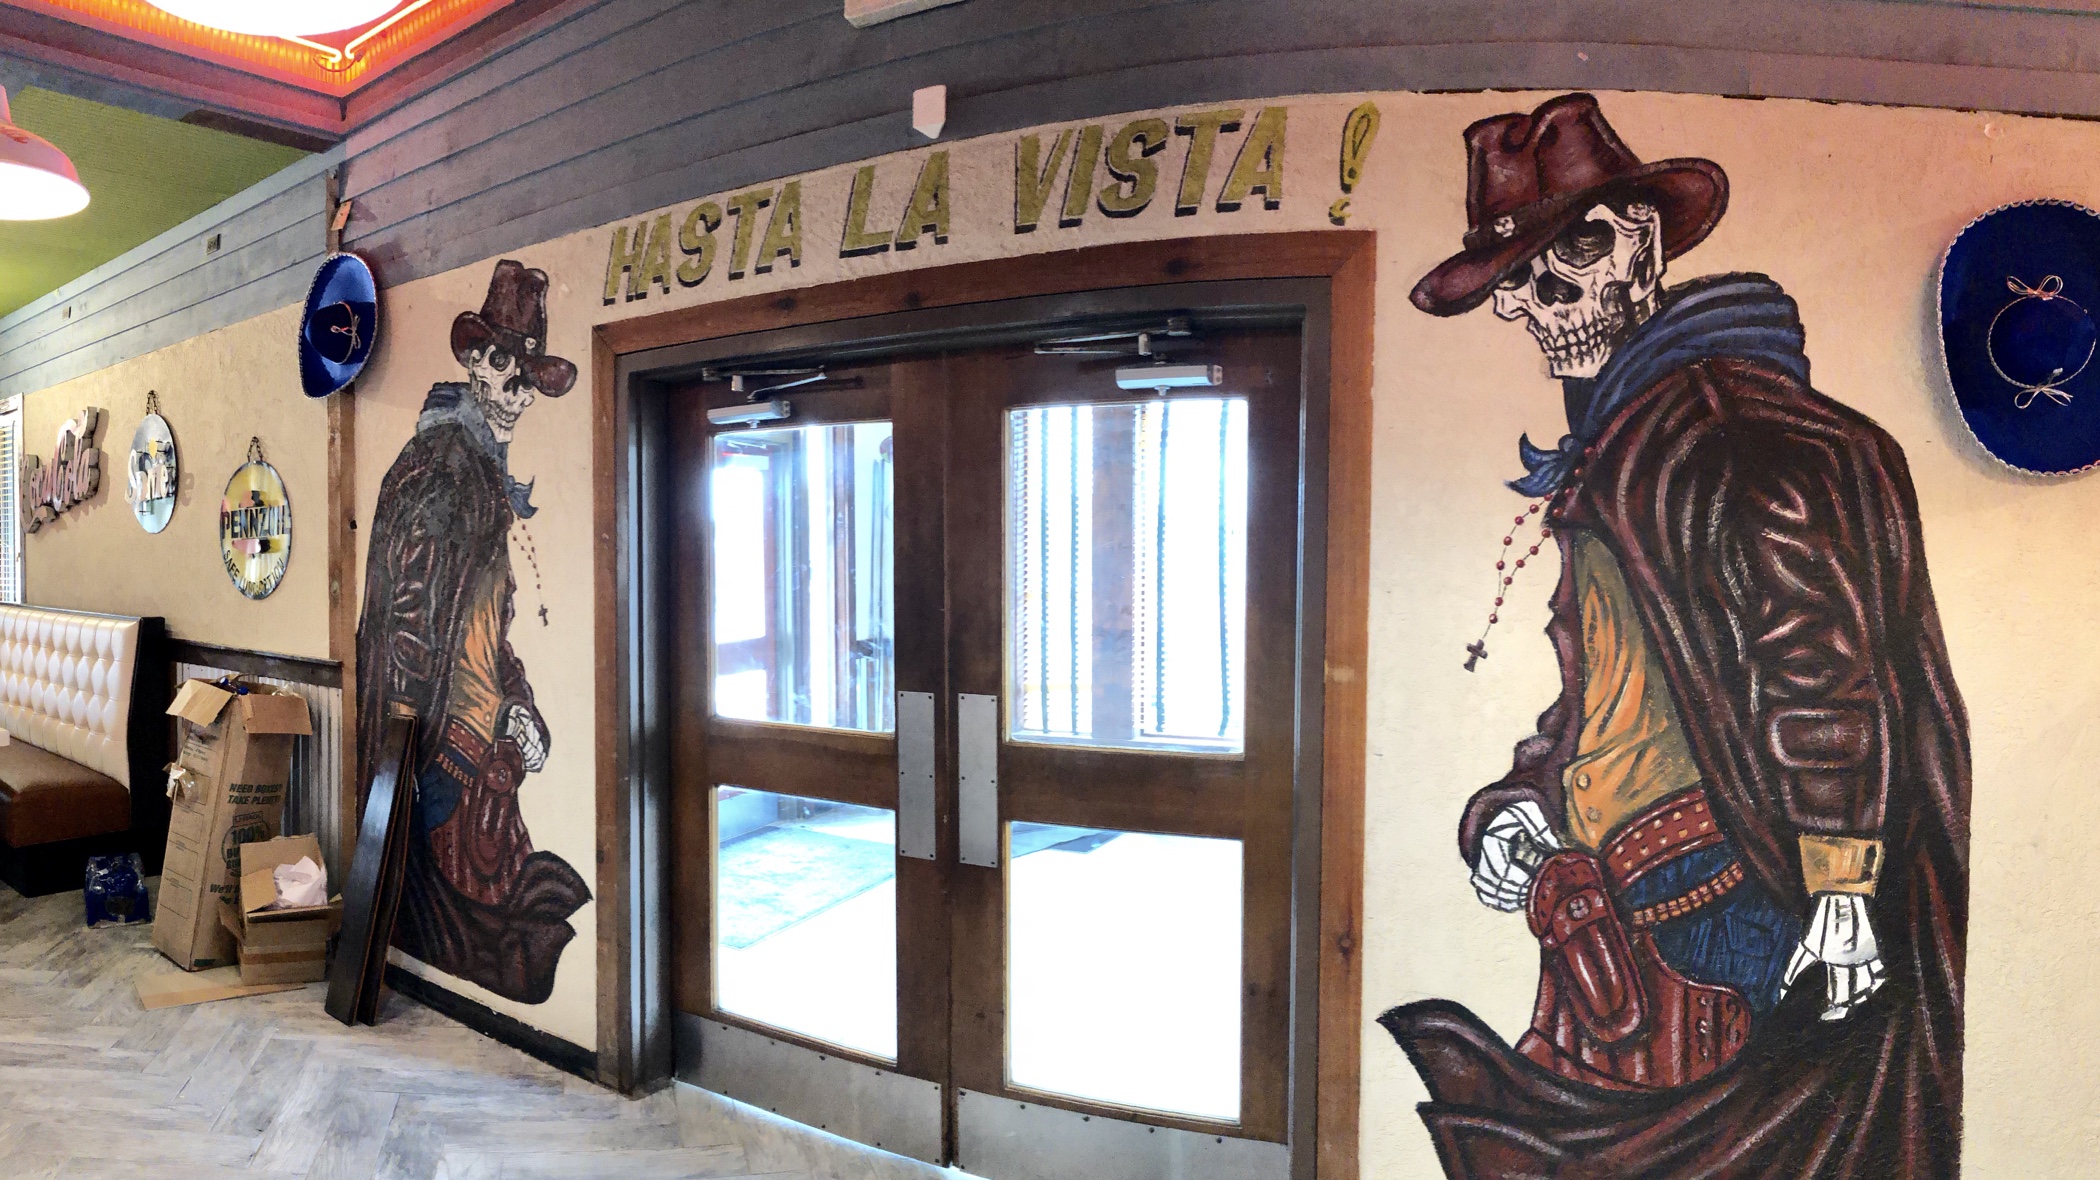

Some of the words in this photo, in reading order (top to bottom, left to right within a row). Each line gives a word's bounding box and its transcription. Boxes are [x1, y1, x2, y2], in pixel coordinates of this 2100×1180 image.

[603, 178, 801, 306] HASTA
[839, 150, 950, 259] LA
[1014, 106, 1287, 234] VISTA
[223, 549, 240, 578] SAFE
[229, 784, 253, 793] NEED
[227, 795, 250, 804] TAKE
